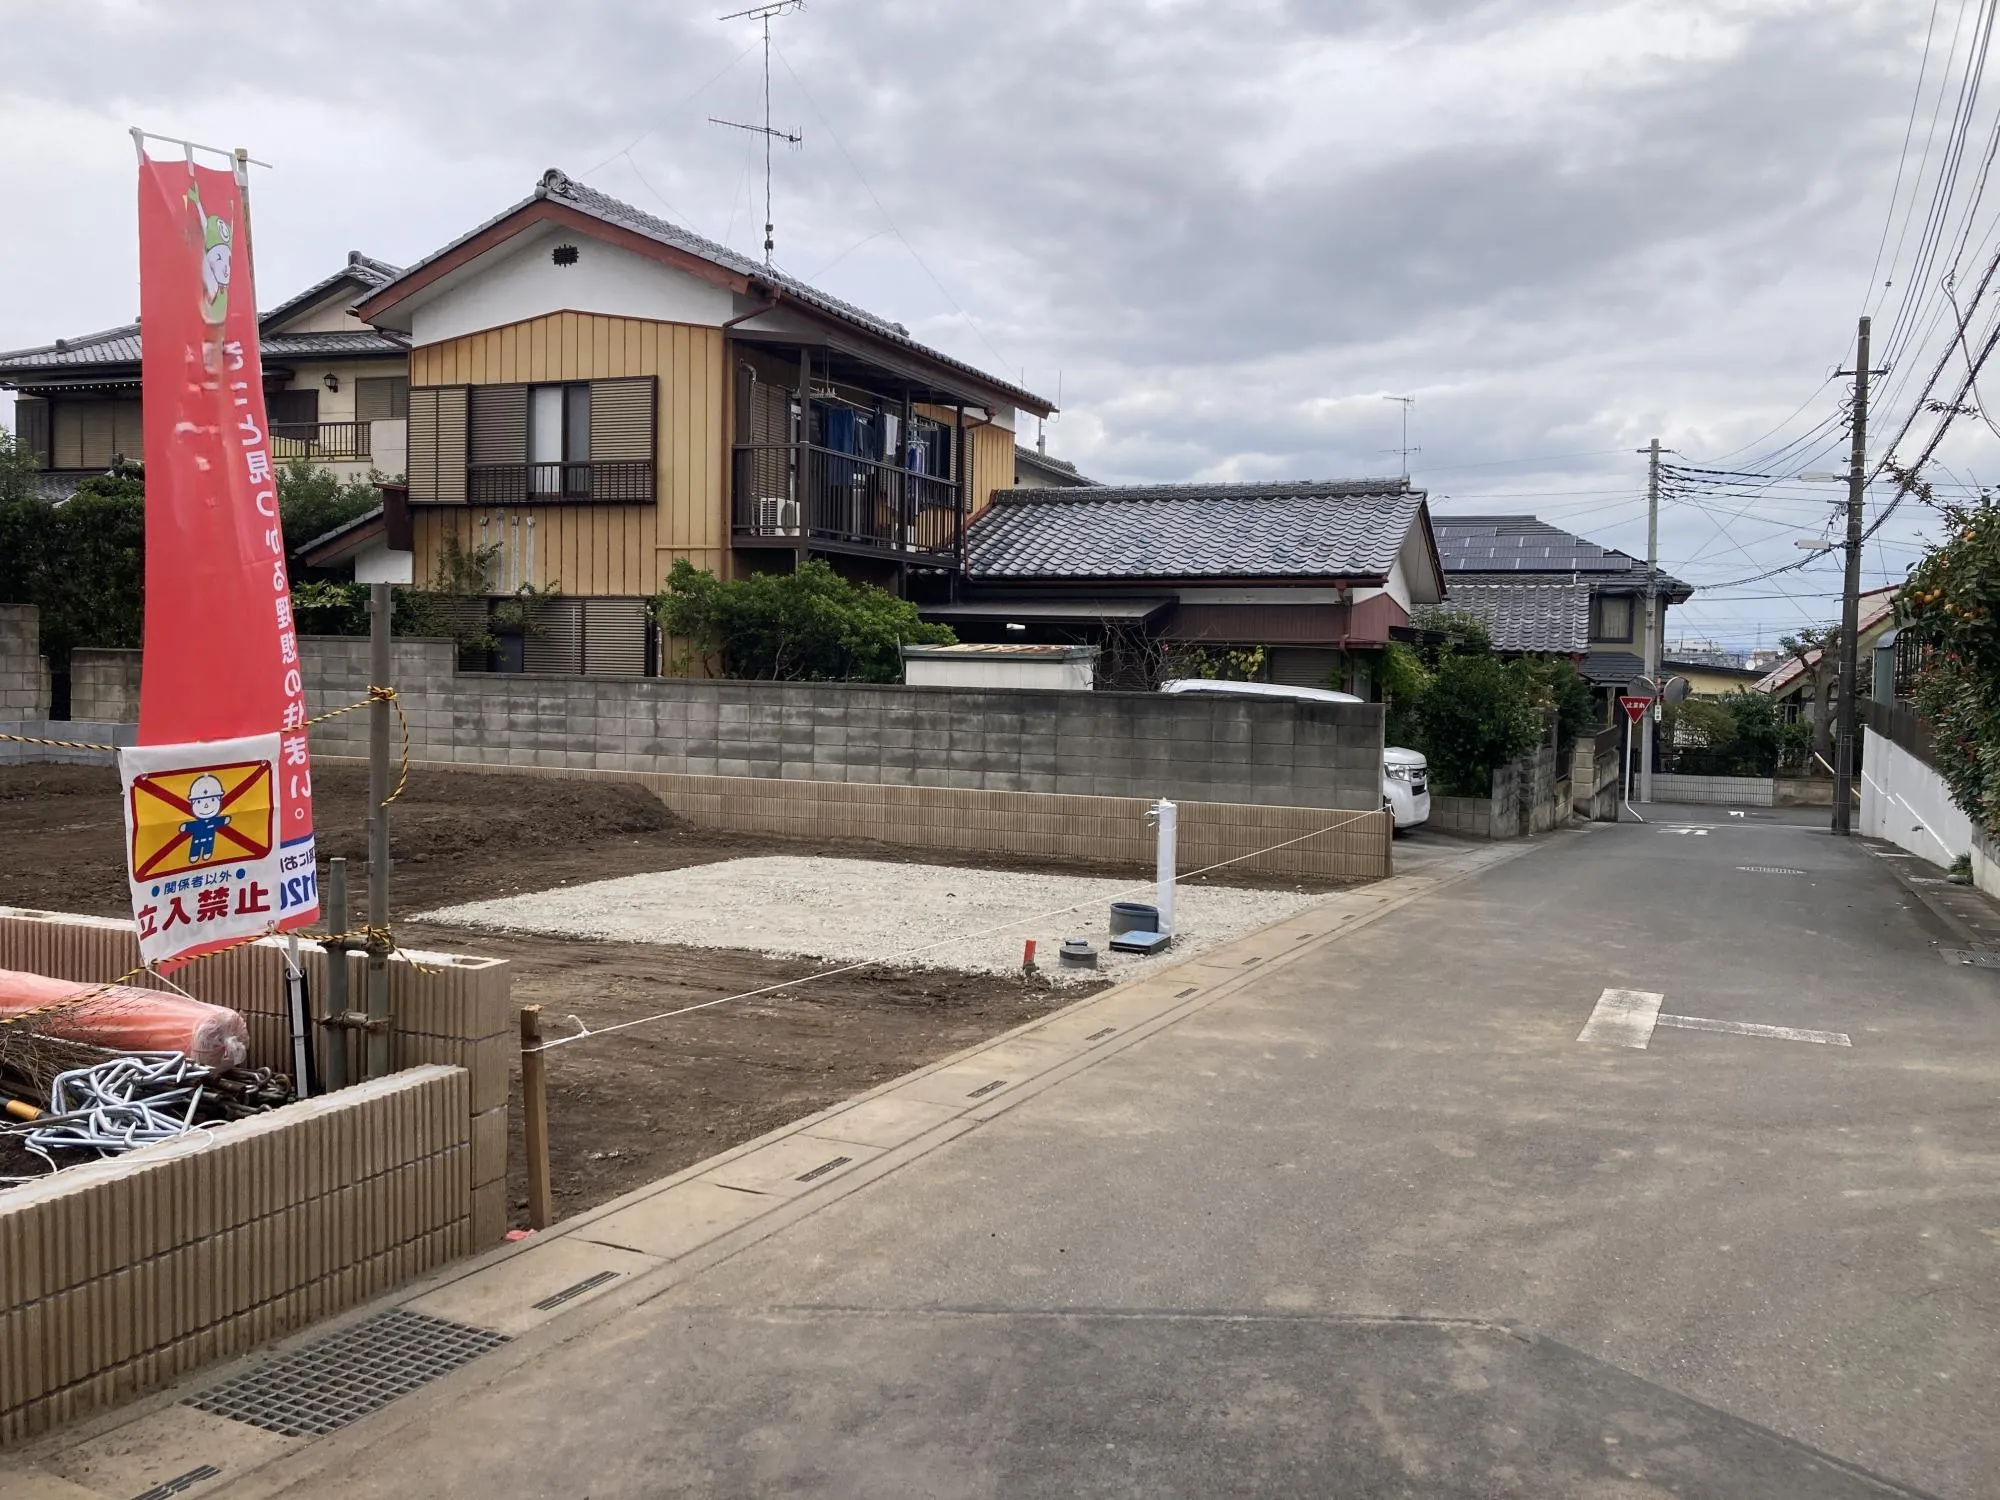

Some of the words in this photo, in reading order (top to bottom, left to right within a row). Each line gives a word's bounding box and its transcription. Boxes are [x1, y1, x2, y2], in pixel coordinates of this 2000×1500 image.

[163, 869, 232, 895] 関係者以外
[137, 881, 271, 941] 立入禁止
